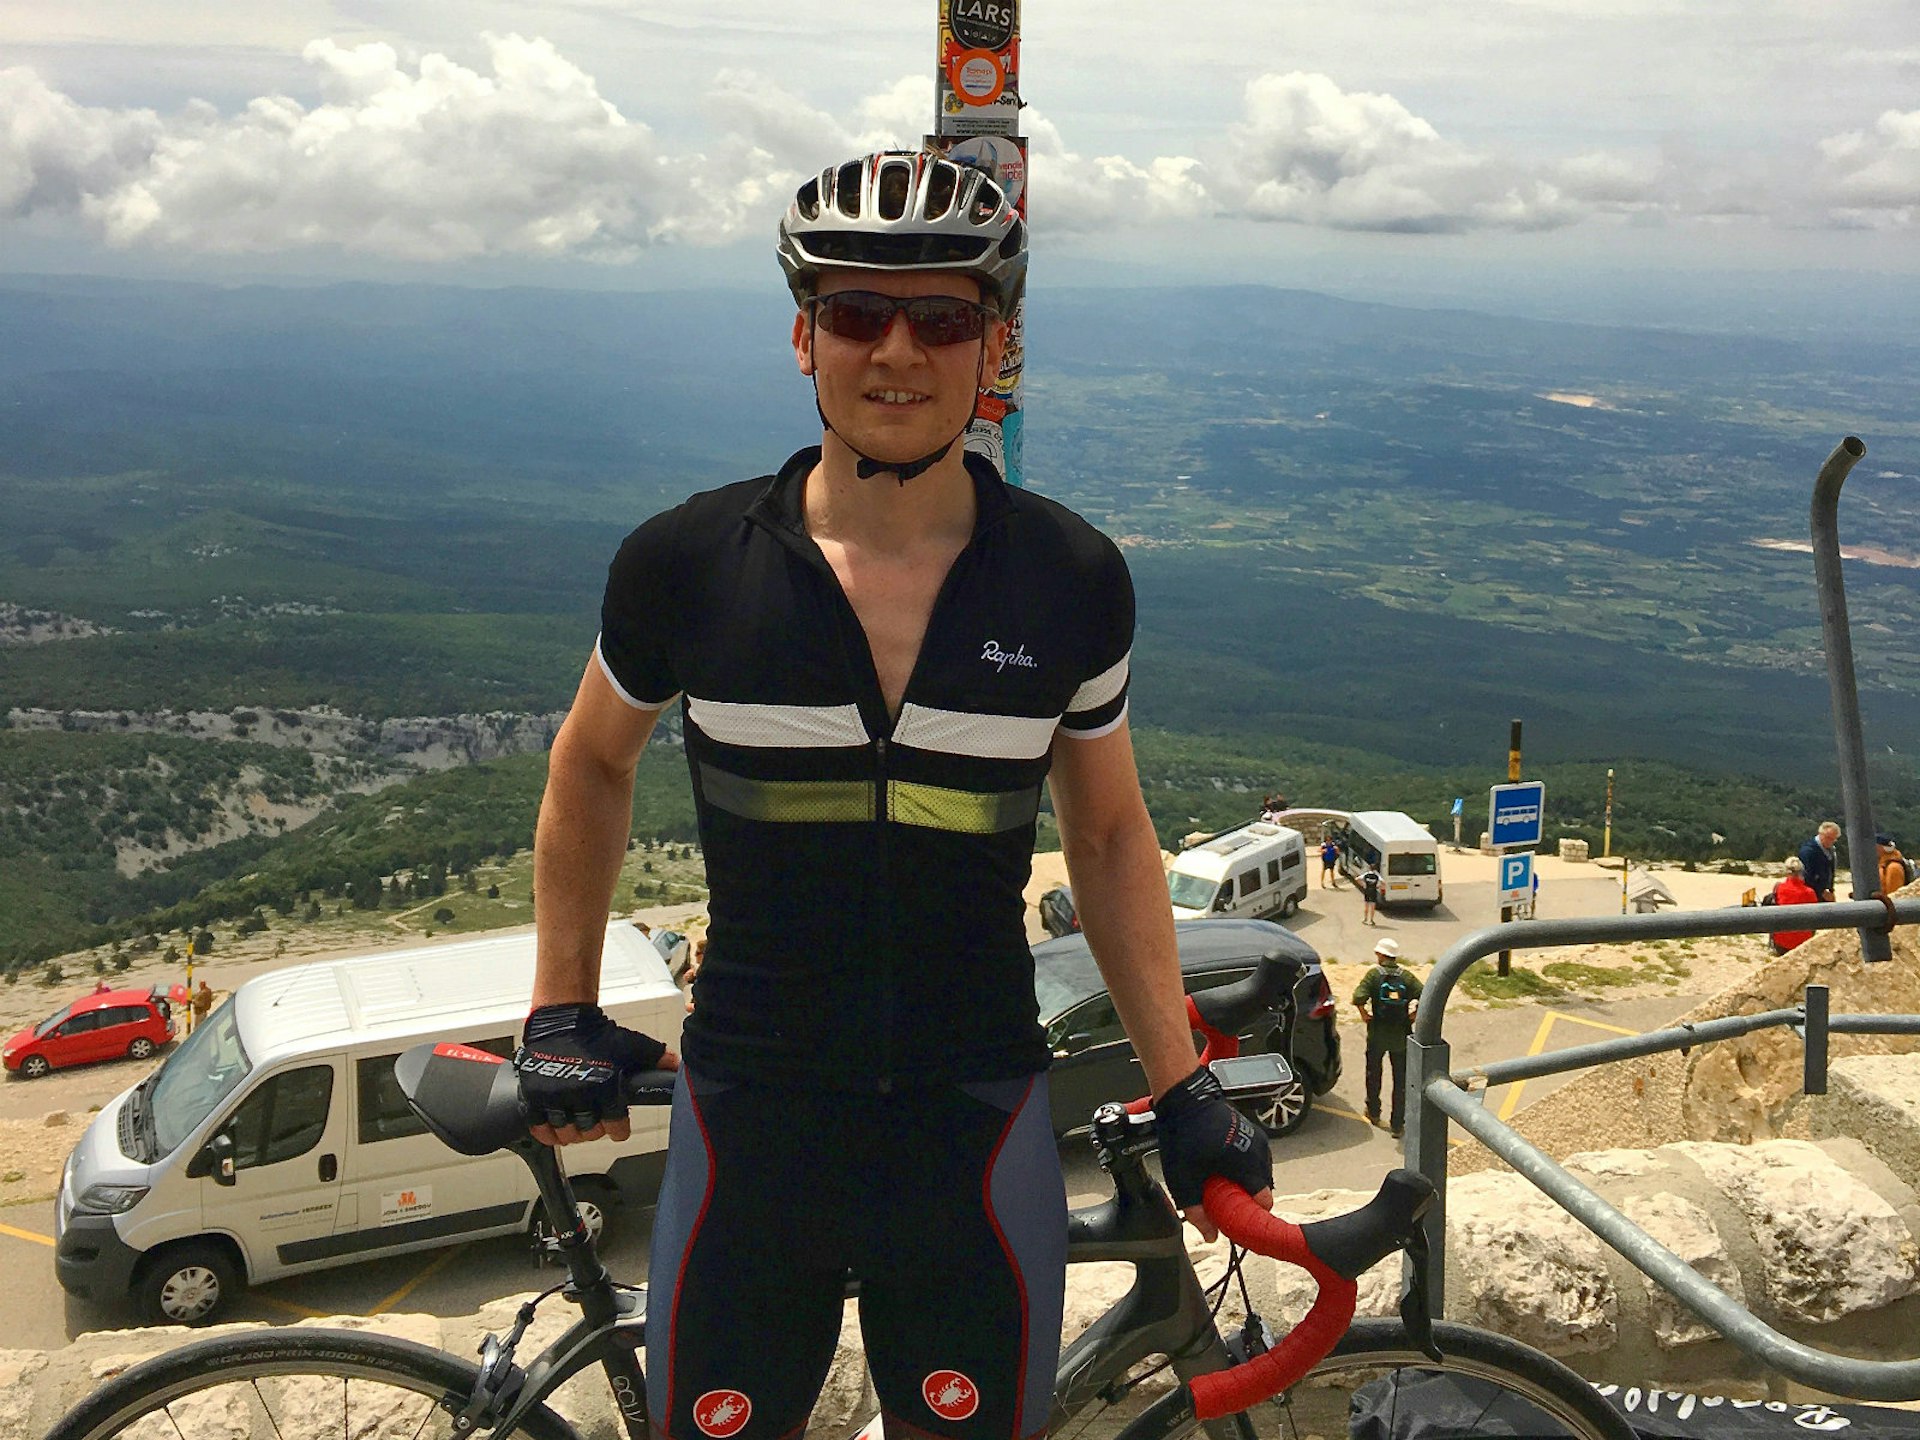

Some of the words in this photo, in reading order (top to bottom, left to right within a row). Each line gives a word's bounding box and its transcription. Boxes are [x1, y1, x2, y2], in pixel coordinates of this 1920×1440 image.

[957, 0, 1011, 27] LARS
[1507, 861, 1525, 886] P
[520, 1057, 614, 1083] CHIBA
